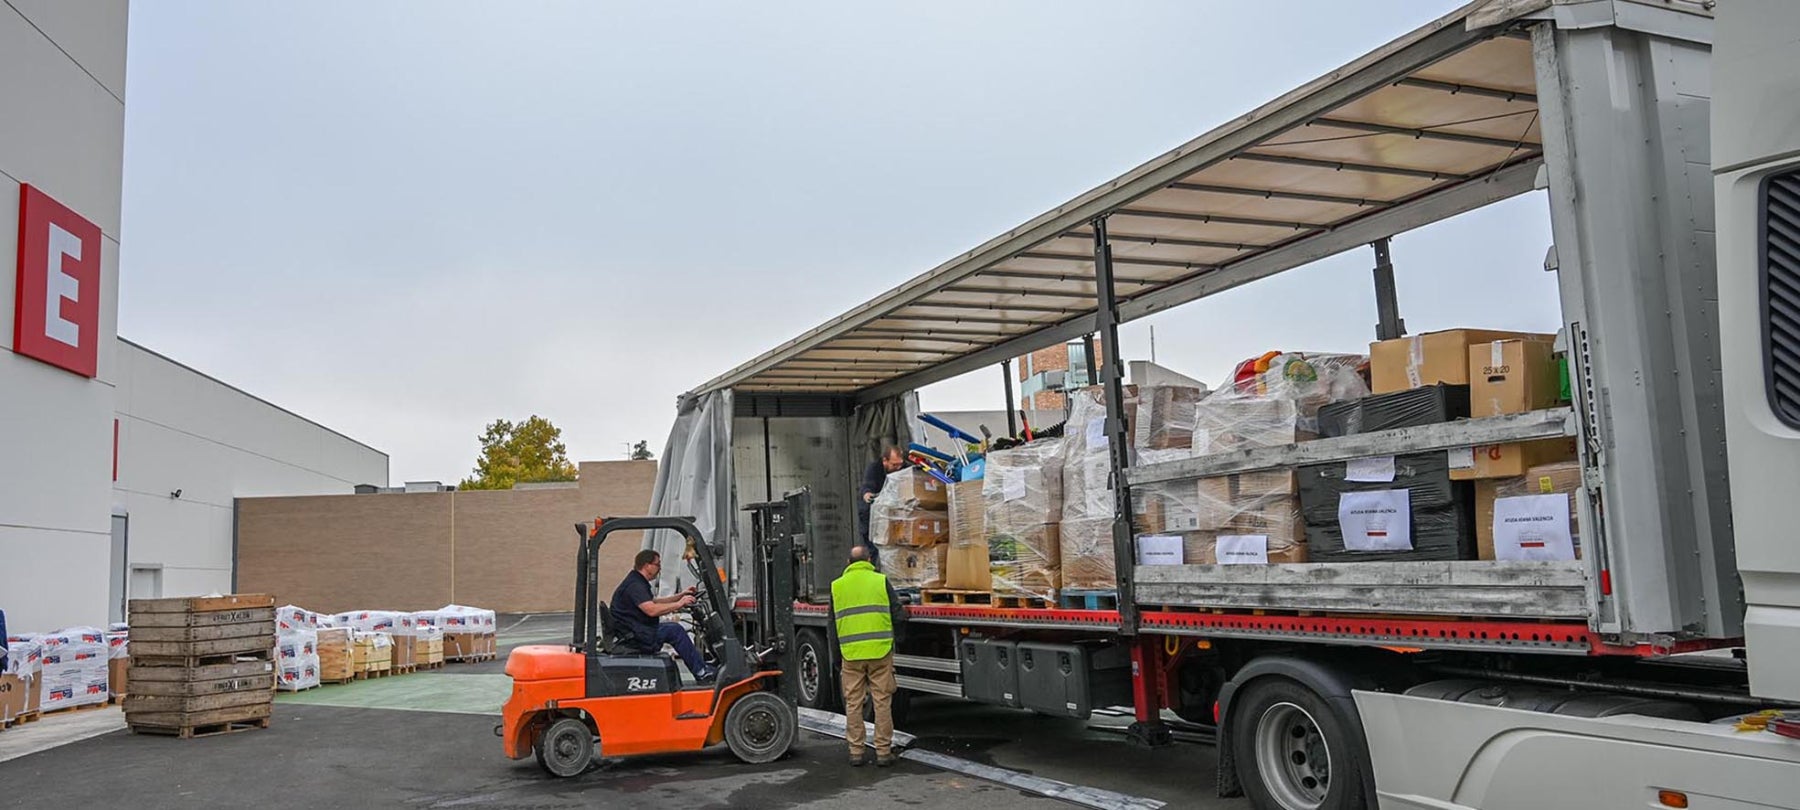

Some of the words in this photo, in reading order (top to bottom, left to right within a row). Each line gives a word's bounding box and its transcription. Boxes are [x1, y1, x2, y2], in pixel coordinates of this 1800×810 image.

[45, 221, 82, 348] E
[1483, 366, 1492, 374] 25
[1500, 365, 1510, 373] 20
